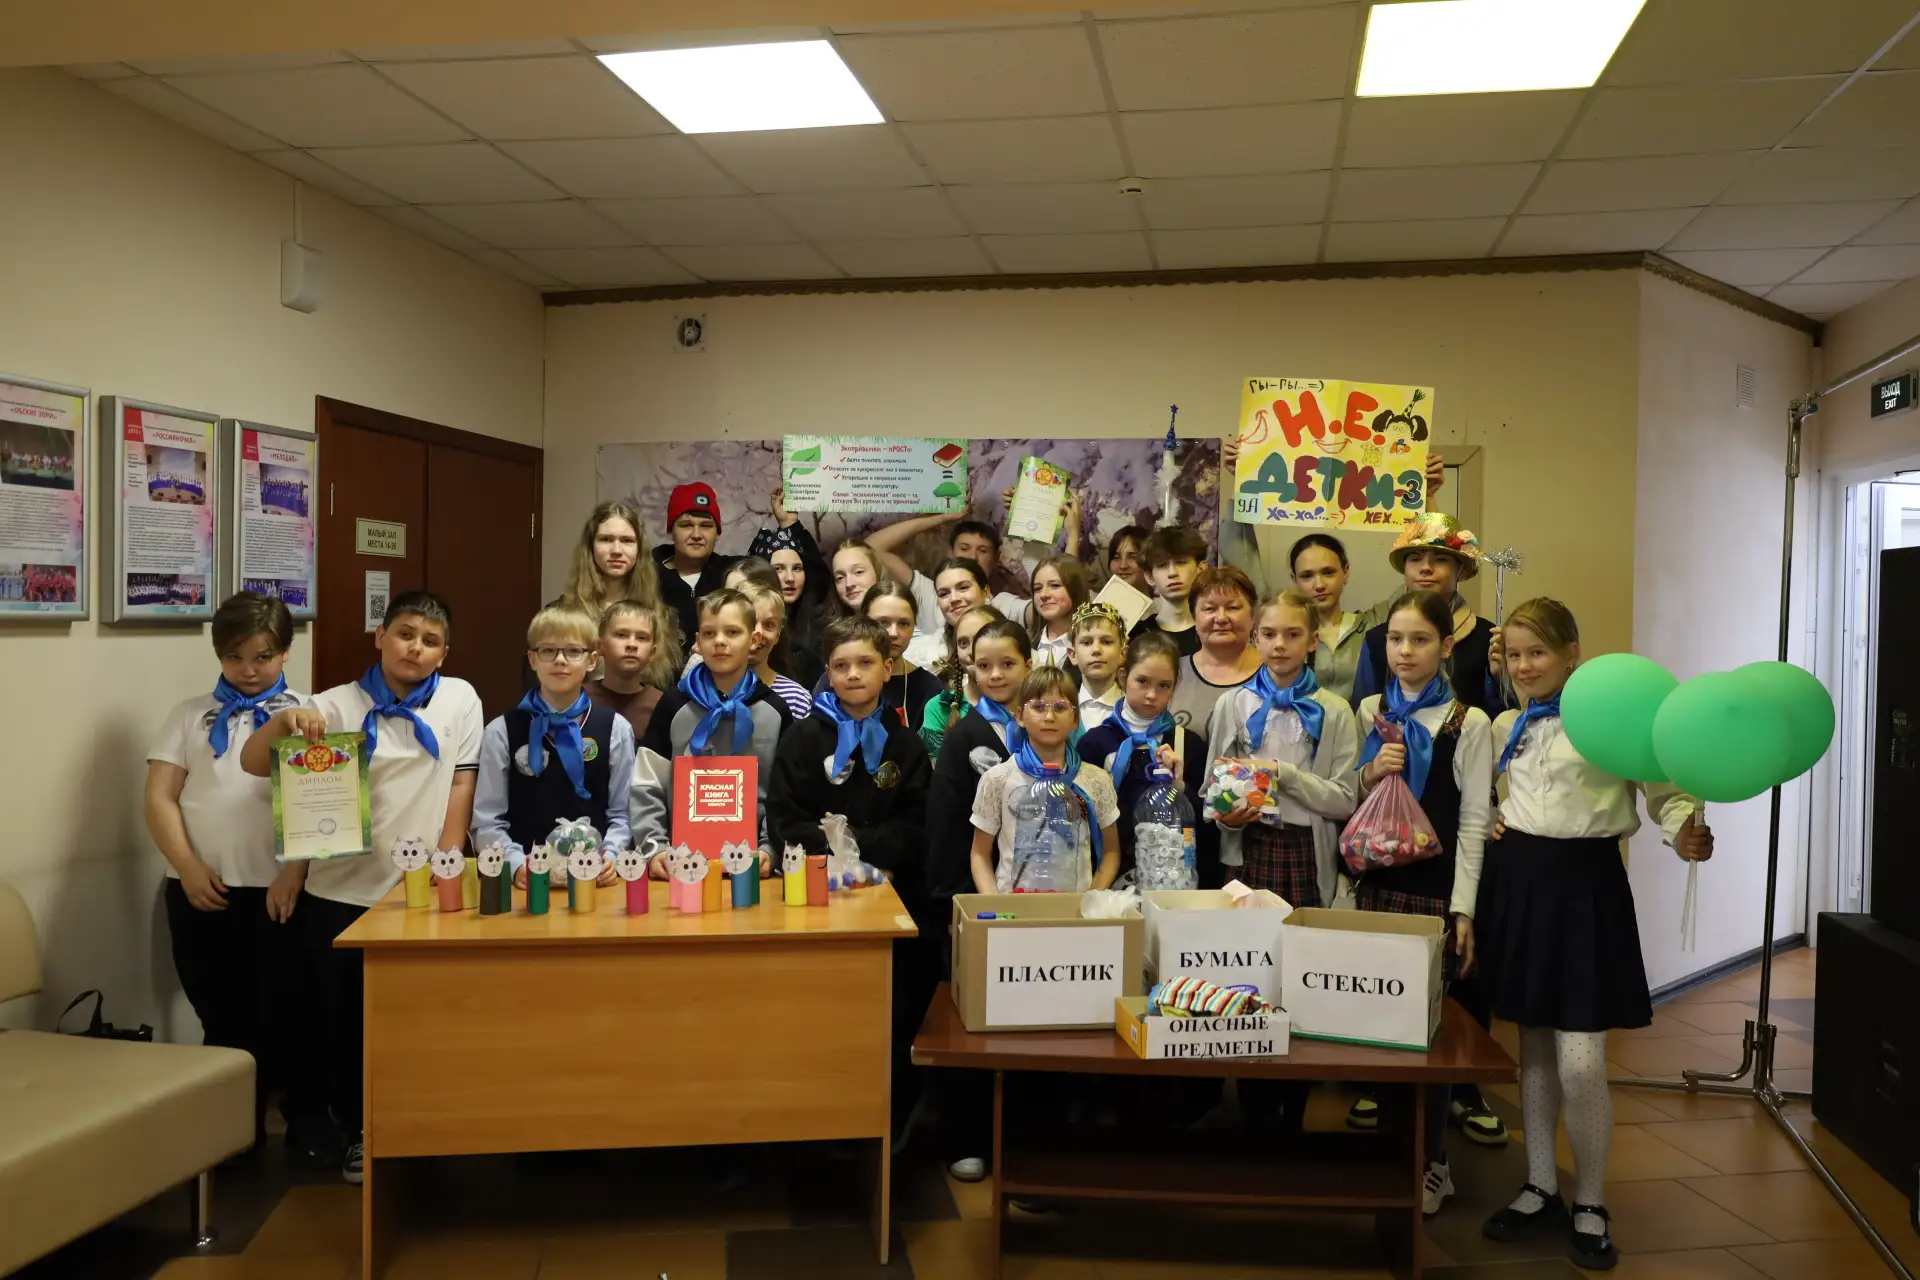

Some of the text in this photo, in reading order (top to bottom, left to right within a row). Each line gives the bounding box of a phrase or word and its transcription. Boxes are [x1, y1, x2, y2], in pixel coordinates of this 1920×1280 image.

[1880, 381, 1901, 399] ВЫХОД
[1884, 398, 1897, 410] EXIT
[152, 431, 196, 445] «РОССИЯНОЧКА»
[840, 445, 881, 453] Экопривычки
[270, 452, 298, 463] «МЕЛОДИЯ»
[367, 528, 397, 539] МАЛЫЙ ЗАЛ
[367, 539, 384, 548] МЕСТА
[297, 775, 343, 786] ДИПЛОМ
[1178, 950, 1275, 970] БУМАГА
[998, 963, 1115, 983] ПЛАСТИК
[1301, 971, 1405, 998] СТЕКЛО
[1169, 1015, 1270, 1033] ОПАСНЫЕ
[1163, 1040, 1274, 1060] ПРЕДМЕТЫ
